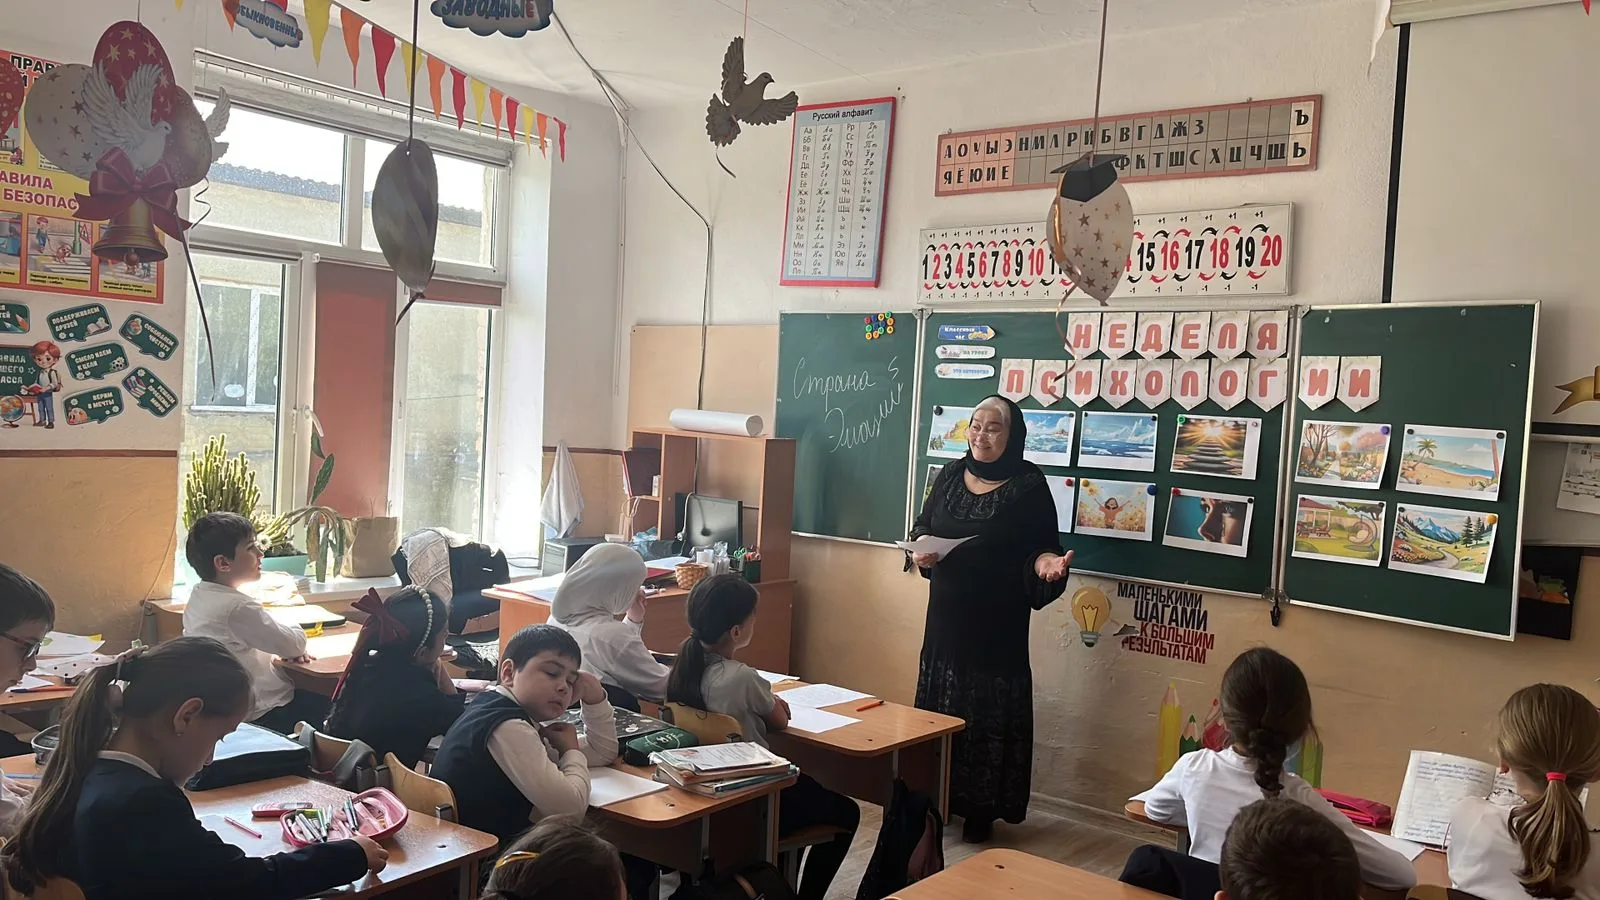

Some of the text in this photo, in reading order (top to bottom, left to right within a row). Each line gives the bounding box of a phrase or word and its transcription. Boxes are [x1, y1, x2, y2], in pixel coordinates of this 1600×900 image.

[10, 55, 59, 74] ПРАВ
[812, 109, 873, 121] Русский алфавит
[922, 254, 928, 280] 1
[933, 254, 941, 279] 2
[944, 253, 951, 279] 3
[955, 253, 963, 278] 4
[967, 252, 975, 278] 5
[979, 251, 987, 278] 6
[991, 251, 999, 277] 7
[1003, 250, 1010, 277] 8
[1015, 249, 1023, 276] 9
[1028, 248, 1044, 276] 10
[1049, 254, 1062, 275] 1
[1137, 242, 1155, 271] 15
[1161, 241, 1179, 270] 16
[1185, 240, 1204, 269] 17
[1210, 238, 1229, 268] 18
[1236, 236, 1255, 267] 19
[1260, 235, 1282, 267] 20
[1073, 322, 1278, 352] НЕДЕЛЯ
[794, 357, 876, 412] Страна
[1118, 582, 1203, 608] МАЛЕНЬКИМИ
[1134, 600, 1208, 631] ШАГАМИ
[1121, 636, 1206, 664] РЕЗУЛЬТАТАМ
[1140, 622, 1215, 650] К БОЛЬШИМ
